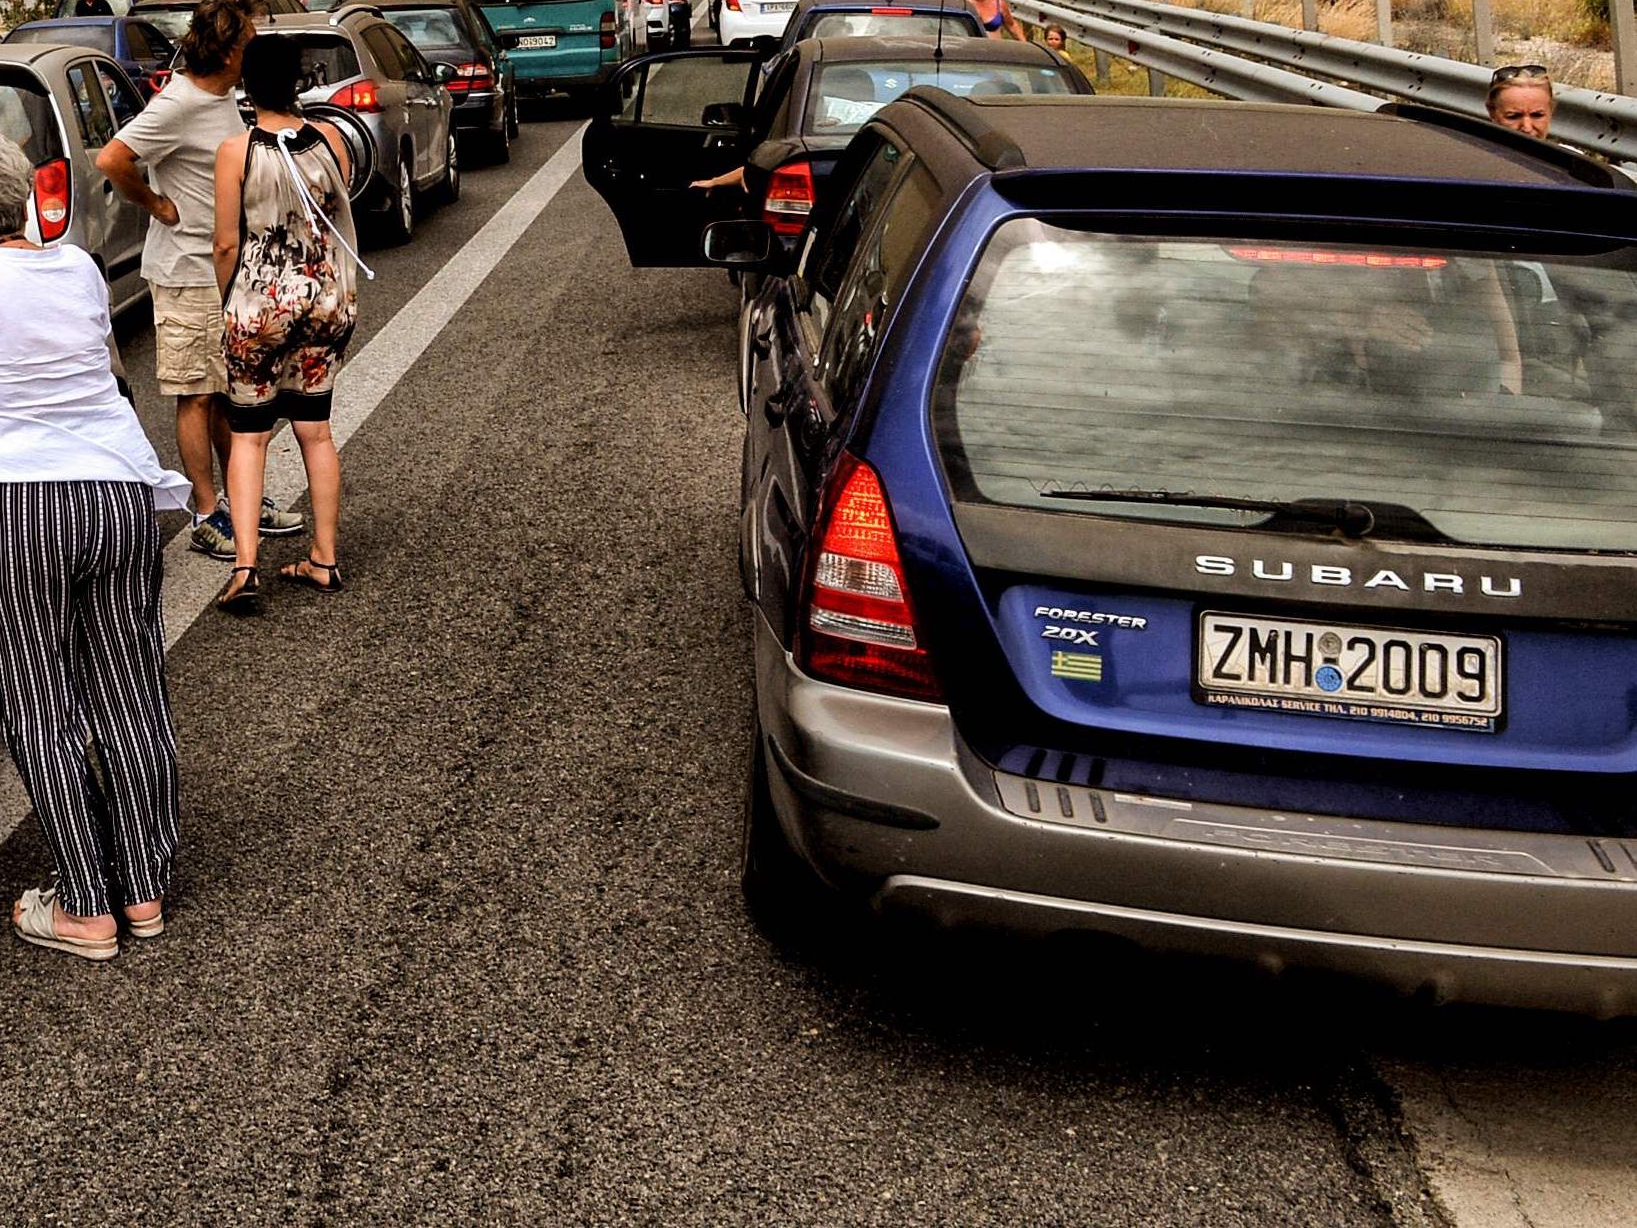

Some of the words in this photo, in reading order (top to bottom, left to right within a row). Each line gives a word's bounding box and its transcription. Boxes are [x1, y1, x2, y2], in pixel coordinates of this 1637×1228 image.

[1195, 555, 1522, 597] SUBARU
[1034, 606, 1147, 629] FORESTER
[1281, 700, 1321, 712] SERVICE
[1349, 707, 1368, 716] 210
[1421, 713, 1440, 723] 210
